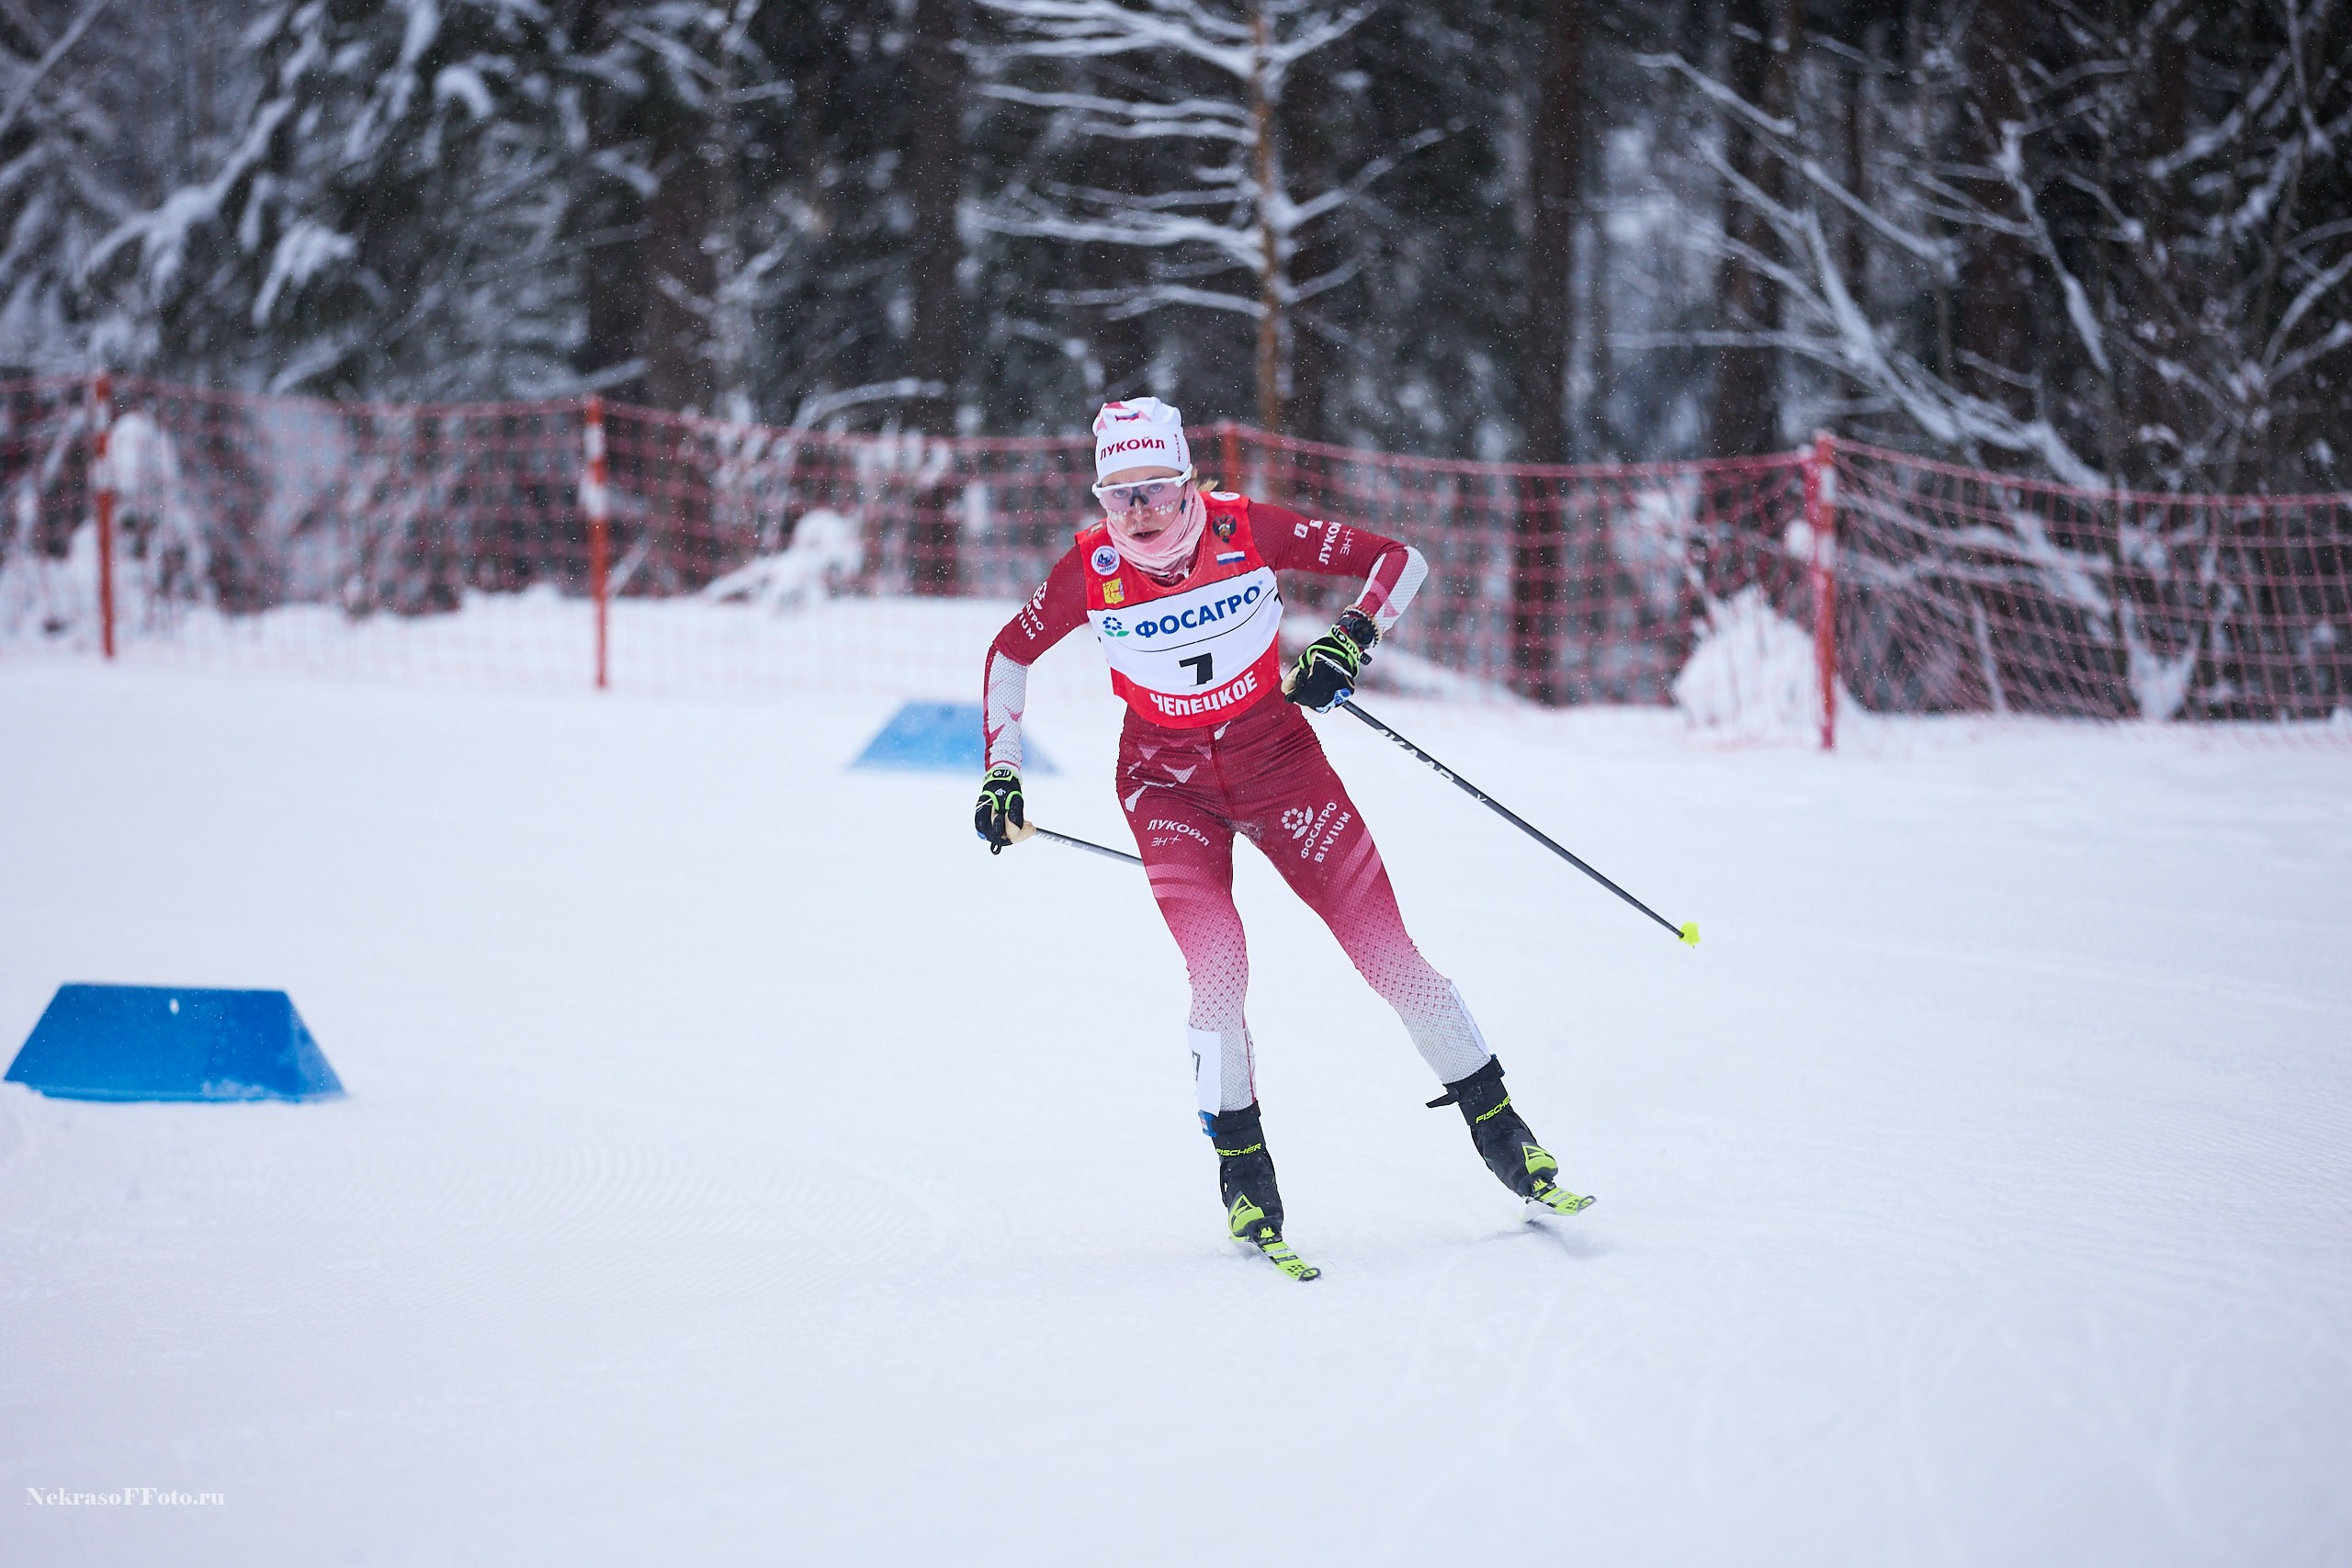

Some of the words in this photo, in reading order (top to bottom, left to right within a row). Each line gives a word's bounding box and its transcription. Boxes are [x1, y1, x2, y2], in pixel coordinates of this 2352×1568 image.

[1100, 435, 1165, 461] ЛУКОЙЛ
[1025, 603, 1045, 631] АГРО
[1135, 585, 1261, 638] ФОСАГРО
[1179, 652, 1213, 687] 7
[1149, 671, 1258, 716] ЧЕПЕЦКОЕ
[1147, 818, 1210, 846] ЛУКОЙЛ
[1301, 802, 1338, 859] ФОСАГРО
[1314, 811, 1351, 863] BIVIUM
[1476, 1095, 1511, 1124] FISCHE
[1216, 1143, 1261, 1156] FISCHER
